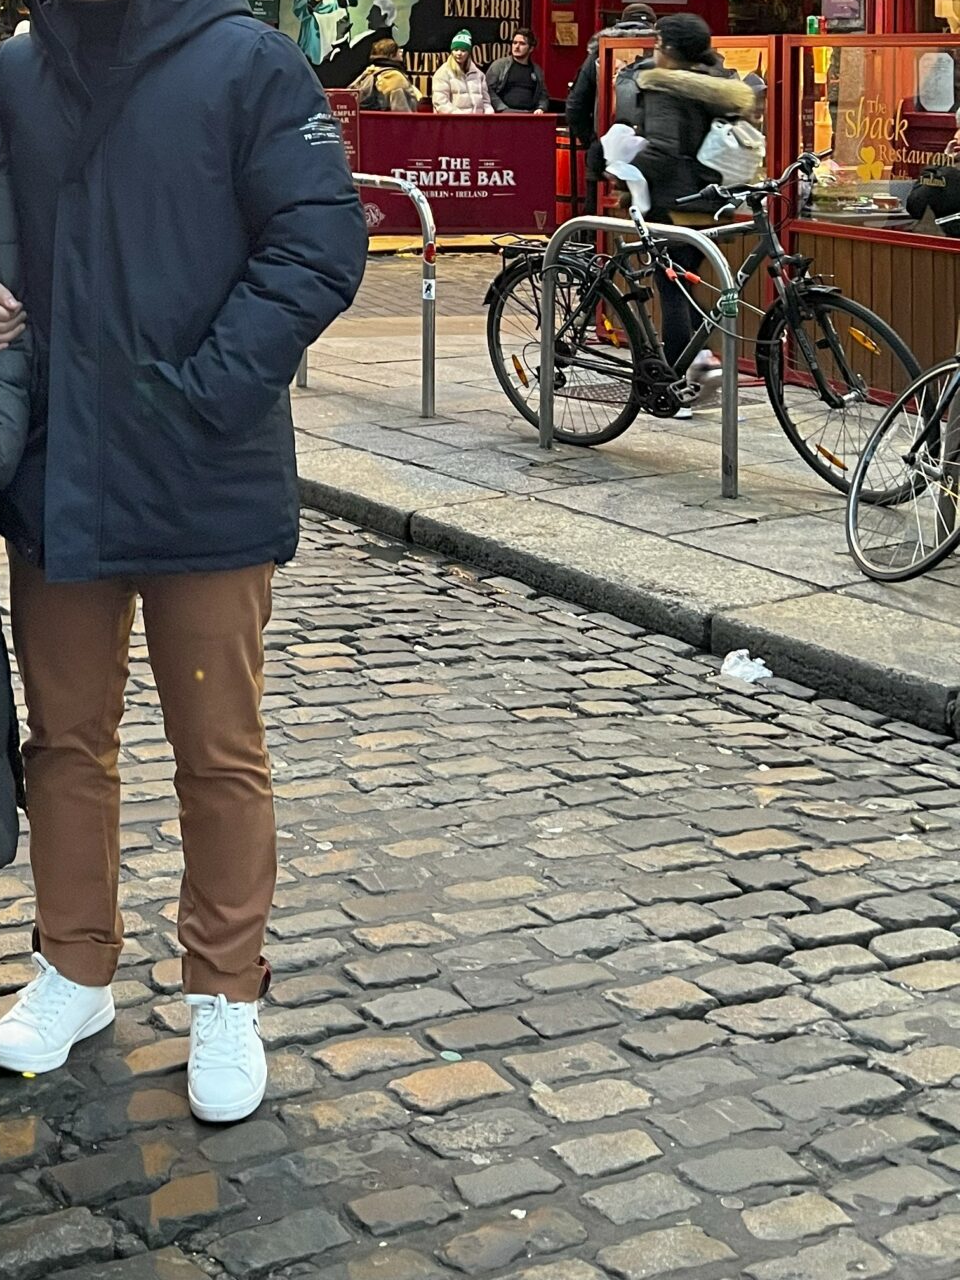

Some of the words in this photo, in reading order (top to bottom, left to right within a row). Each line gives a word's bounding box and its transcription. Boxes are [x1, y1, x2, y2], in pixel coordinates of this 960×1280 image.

[499, 21, 518, 41] OF
[867, 94, 887, 116] The
[844, 96, 910, 148] Shack
[438, 156, 471, 170] THE
[879, 144, 955, 168] Restaurant
[391, 168, 472, 187] TEMPLE
[477, 170, 517, 187] BAR
[422, 190, 450, 198] UBLIN
[455, 190, 489, 199] IRELAND
